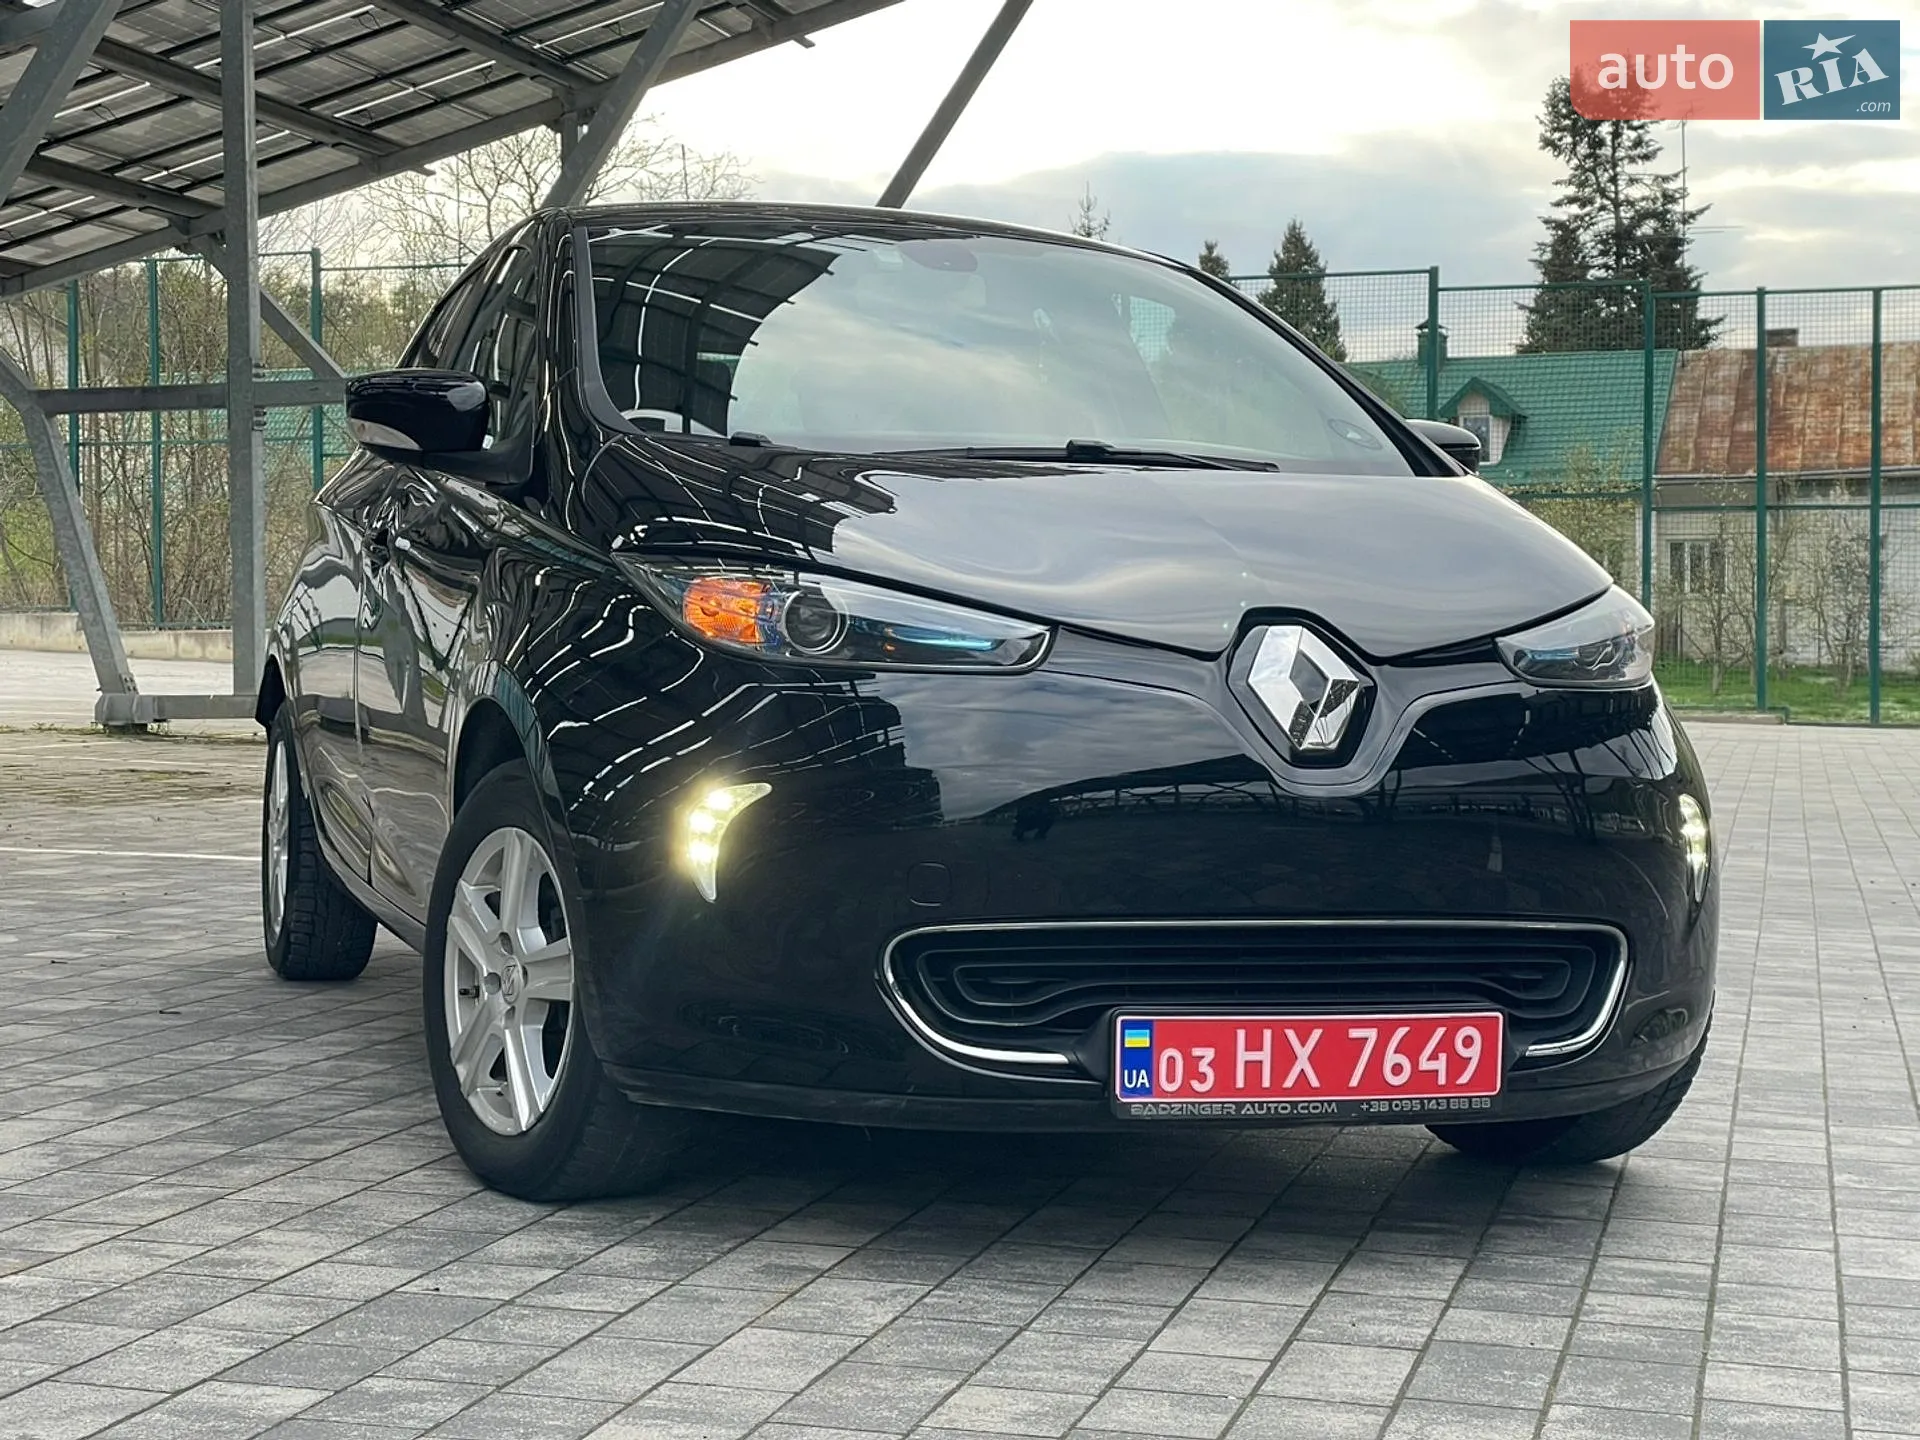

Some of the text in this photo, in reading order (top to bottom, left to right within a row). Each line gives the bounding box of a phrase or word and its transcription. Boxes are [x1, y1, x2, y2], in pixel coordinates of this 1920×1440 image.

[1124, 1069, 1150, 1088] UA
[1158, 1025, 1483, 1093] 03 HX 7649
